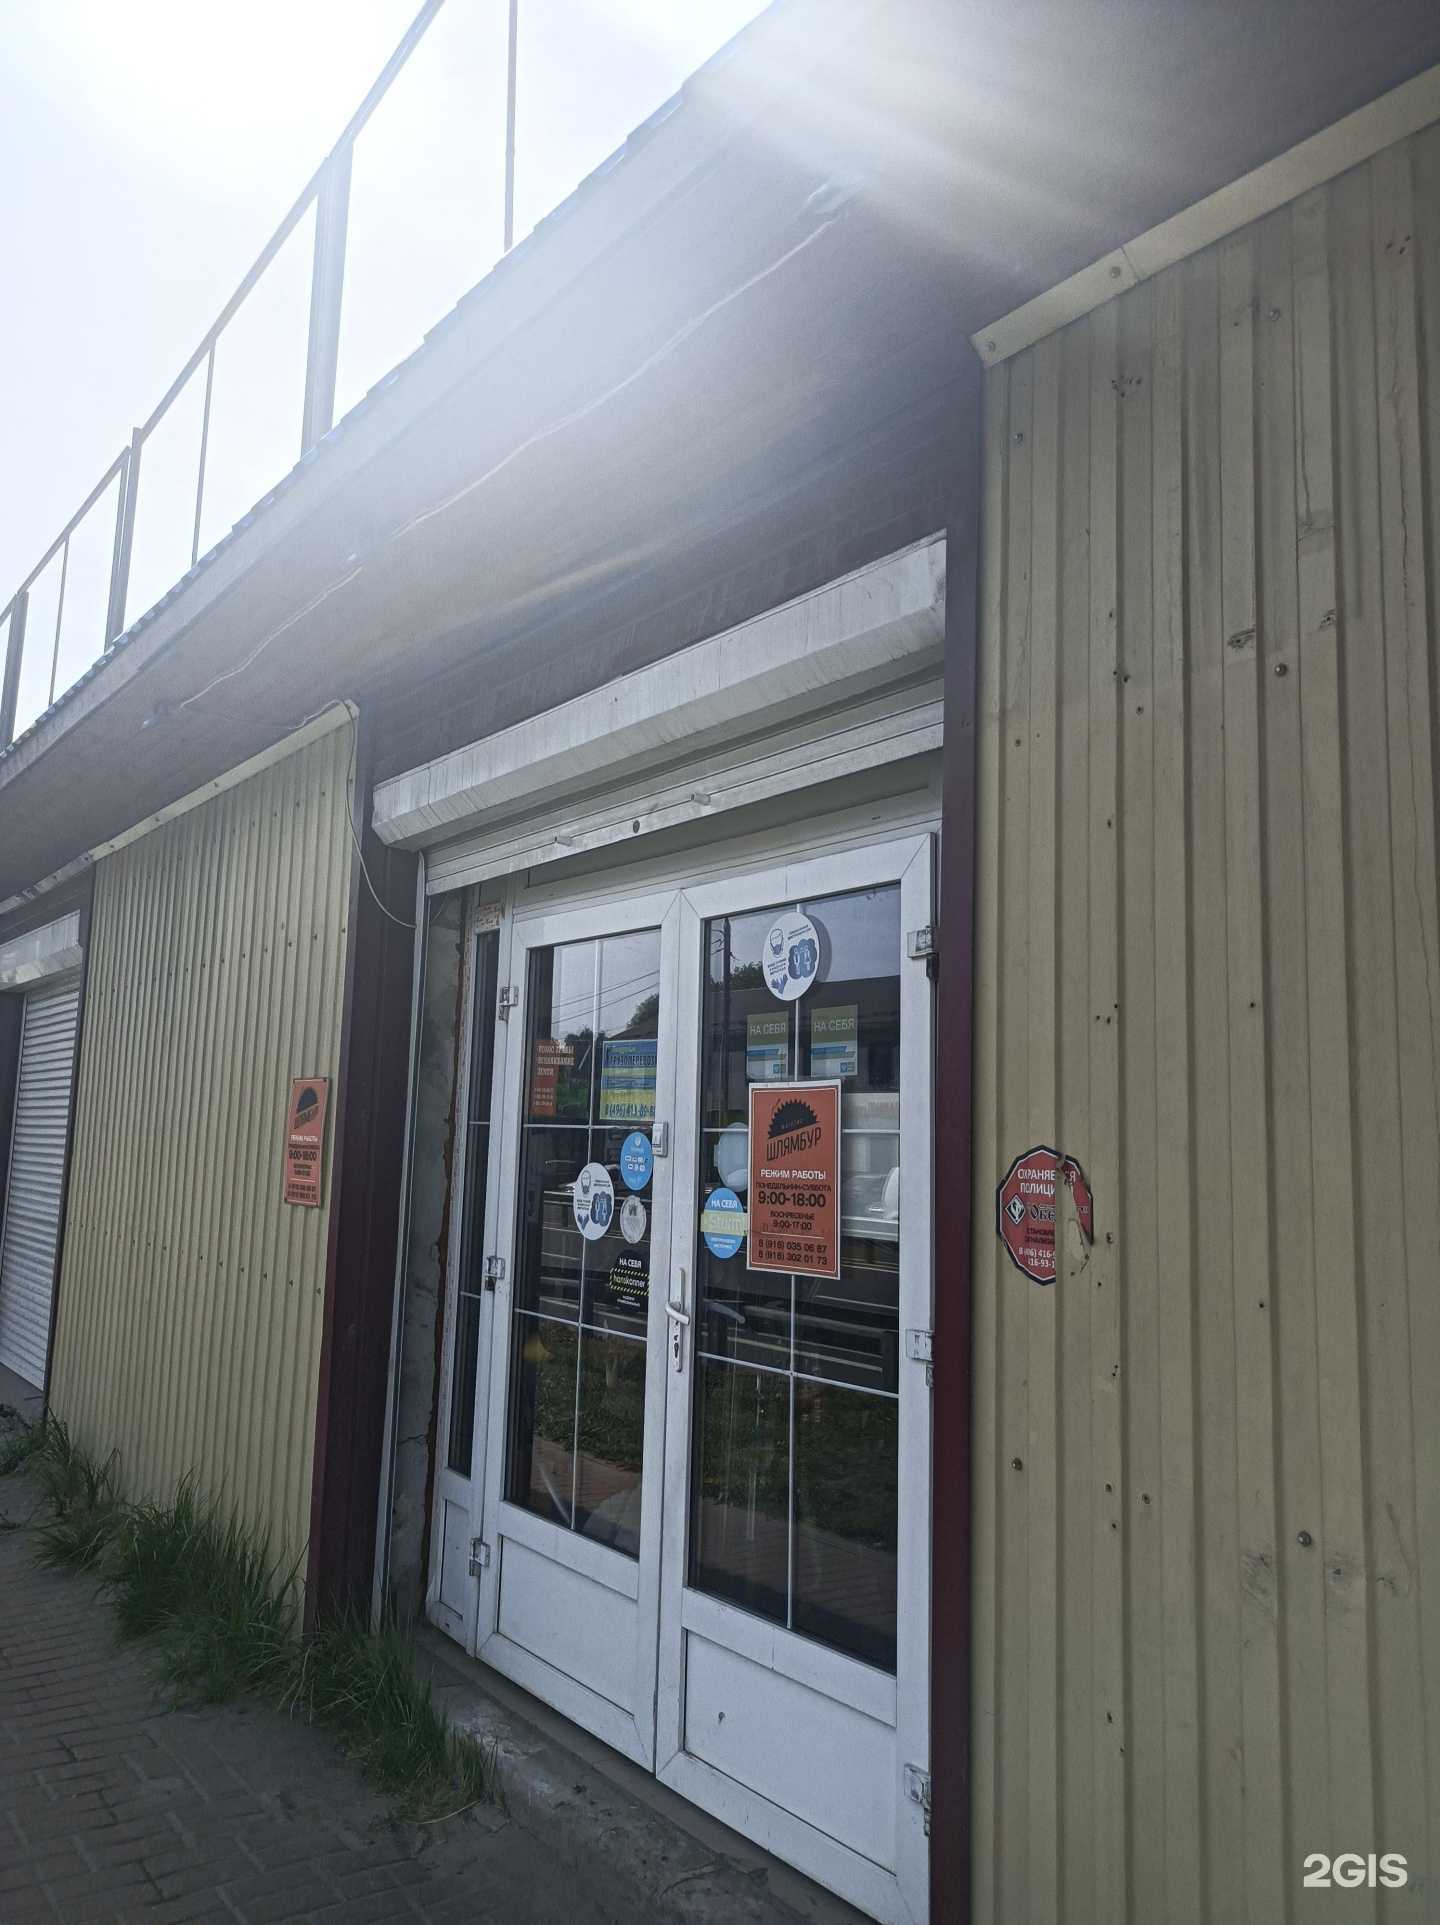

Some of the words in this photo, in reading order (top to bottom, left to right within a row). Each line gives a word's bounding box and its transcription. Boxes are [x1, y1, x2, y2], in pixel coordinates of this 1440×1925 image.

[750, 1024, 761, 1035] НА
[763, 1022, 786, 1034] СЕБЯ
[814, 1021, 827, 1032] НА
[828, 1018, 855, 1031] СЕБЯ
[766, 1127, 822, 1162] ШЛЯМБУР
[760, 1169, 790, 1178] РЕЖИМ
[792, 1170, 826, 1179] РАБОТЫ
[1018, 1169, 1076, 1183] ОХРАНЯЕЯ
[711, 1199, 720, 1208] НА
[721, 1200, 738, 1209] СЕБЯ
[758, 1191, 826, 1207] 9:00-18:00
[619, 1258, 627, 1266] НА
[627, 1259, 642, 1269] СЕБЯ
